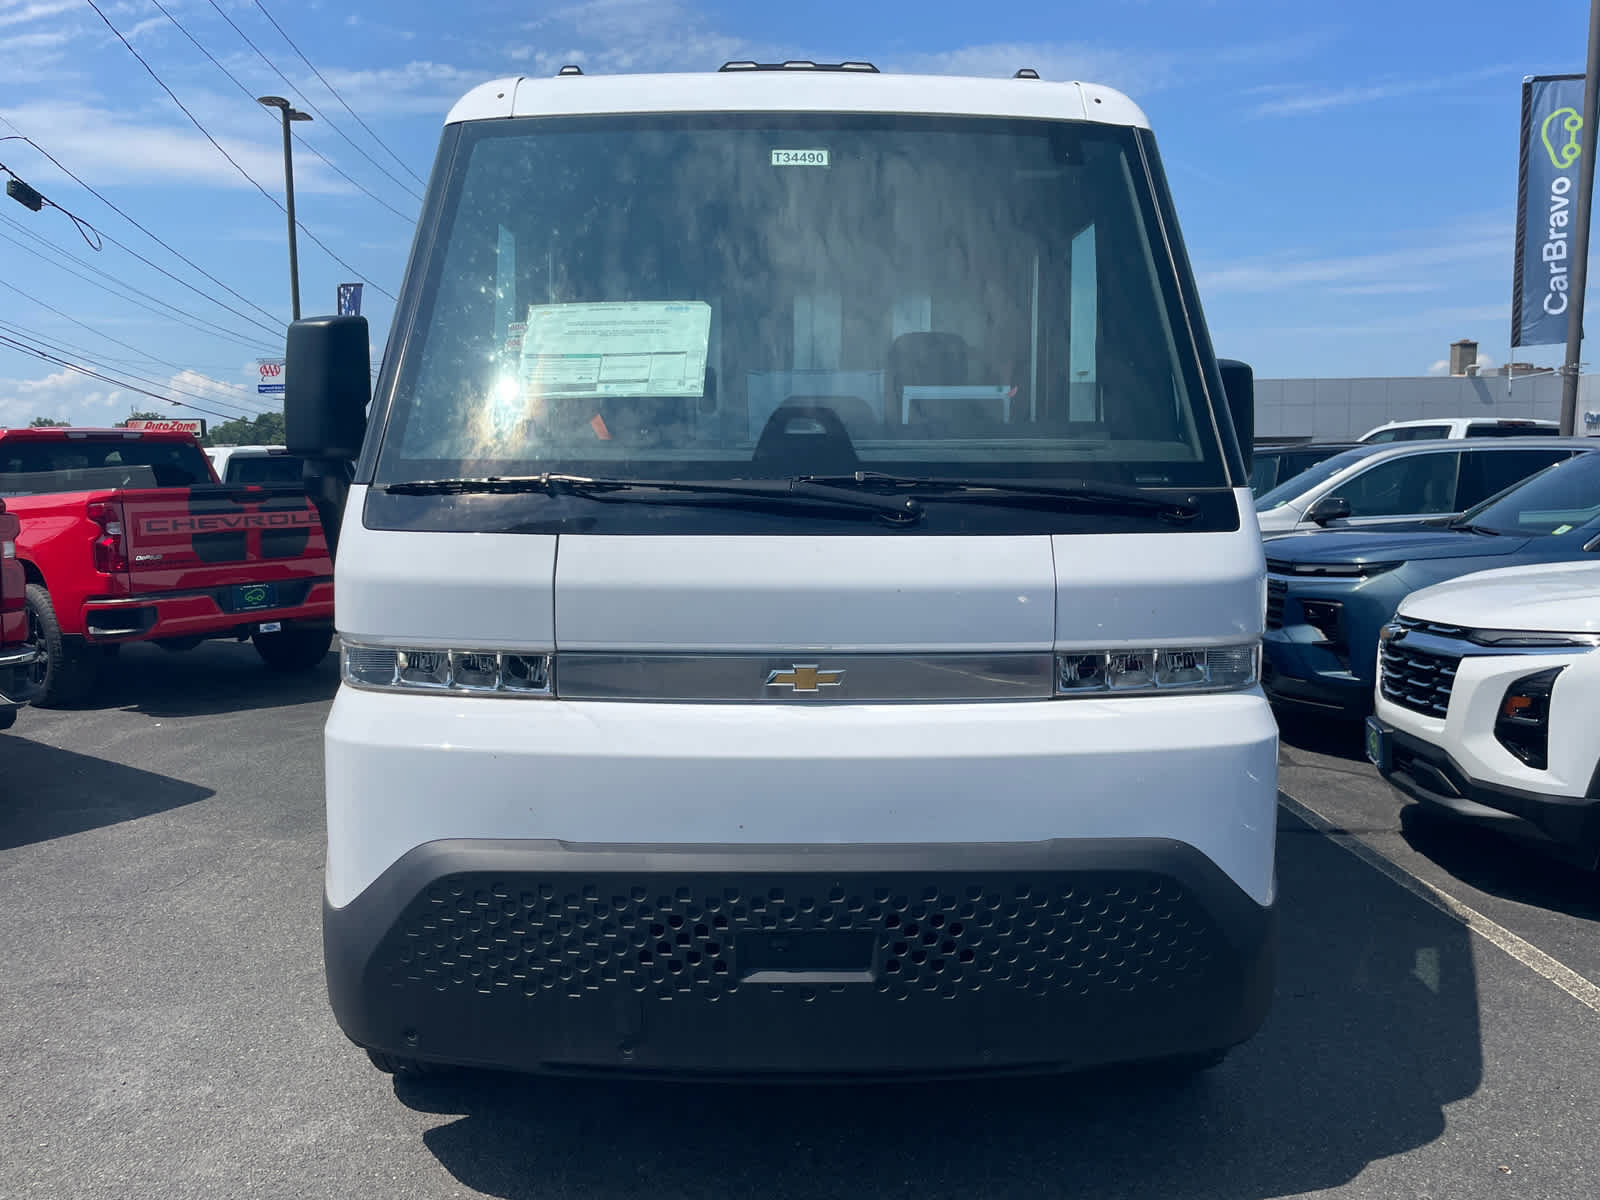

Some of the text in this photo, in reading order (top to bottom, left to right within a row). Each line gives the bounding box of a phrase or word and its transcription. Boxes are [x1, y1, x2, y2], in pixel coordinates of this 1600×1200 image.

[773, 152, 824, 163] T34490
[1542, 176, 1572, 315] CarBravo
[144, 421, 197, 433] AutoZone
[146, 511, 320, 532] CHEVROLE
